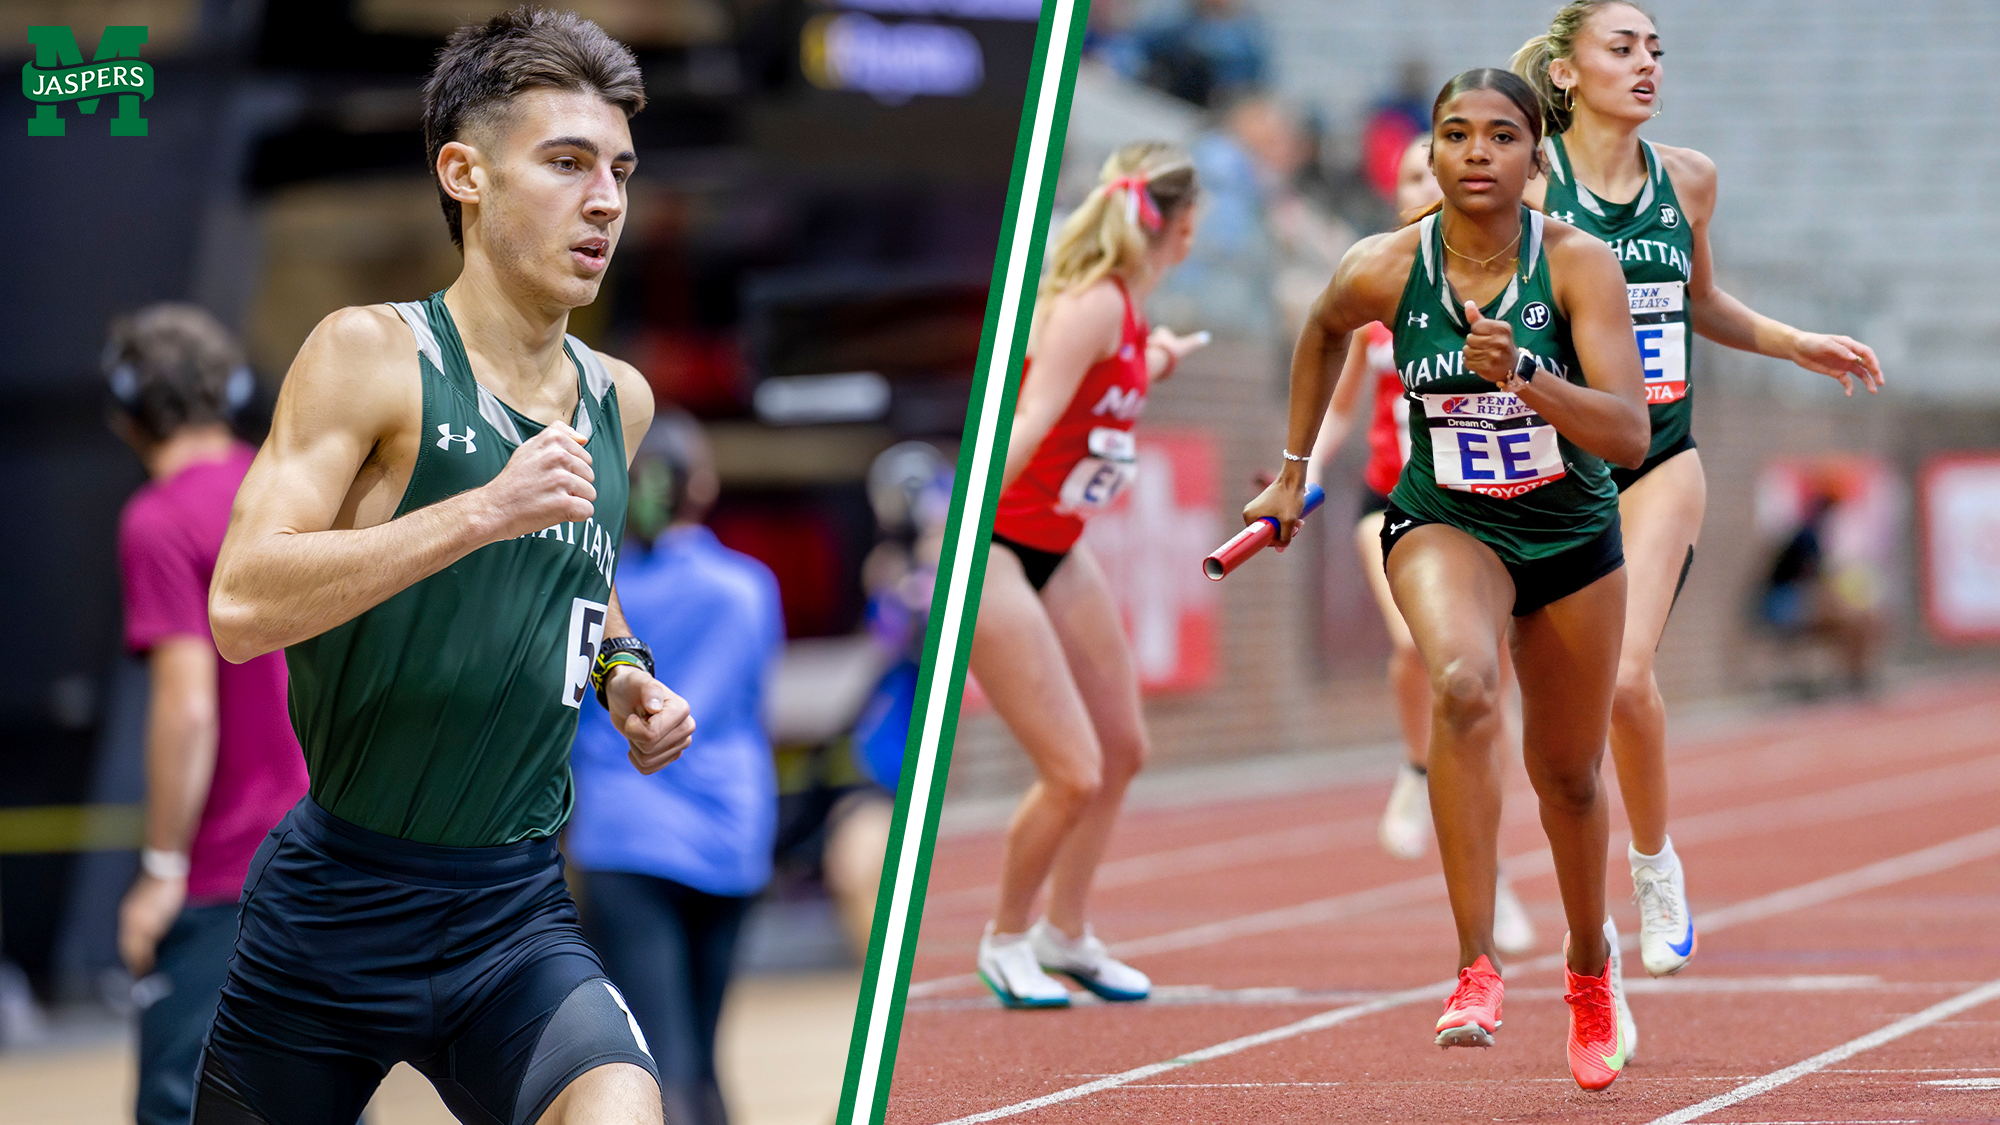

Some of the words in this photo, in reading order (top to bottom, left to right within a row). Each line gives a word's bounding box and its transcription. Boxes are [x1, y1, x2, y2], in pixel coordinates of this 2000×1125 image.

[1661, 207, 1676, 223] JP
[1607, 239, 1691, 283] HATTAN
[1631, 298, 1669, 309] ELAYS
[1525, 305, 1546, 326] JP
[1477, 396, 1519, 406] PENN
[1447, 418, 1479, 428] Dream
[1480, 420, 1497, 431] On.
[1456, 432, 1539, 480] EE
[1475, 479, 1551, 499] TOYOTA
[573, 607, 605, 703] 5
